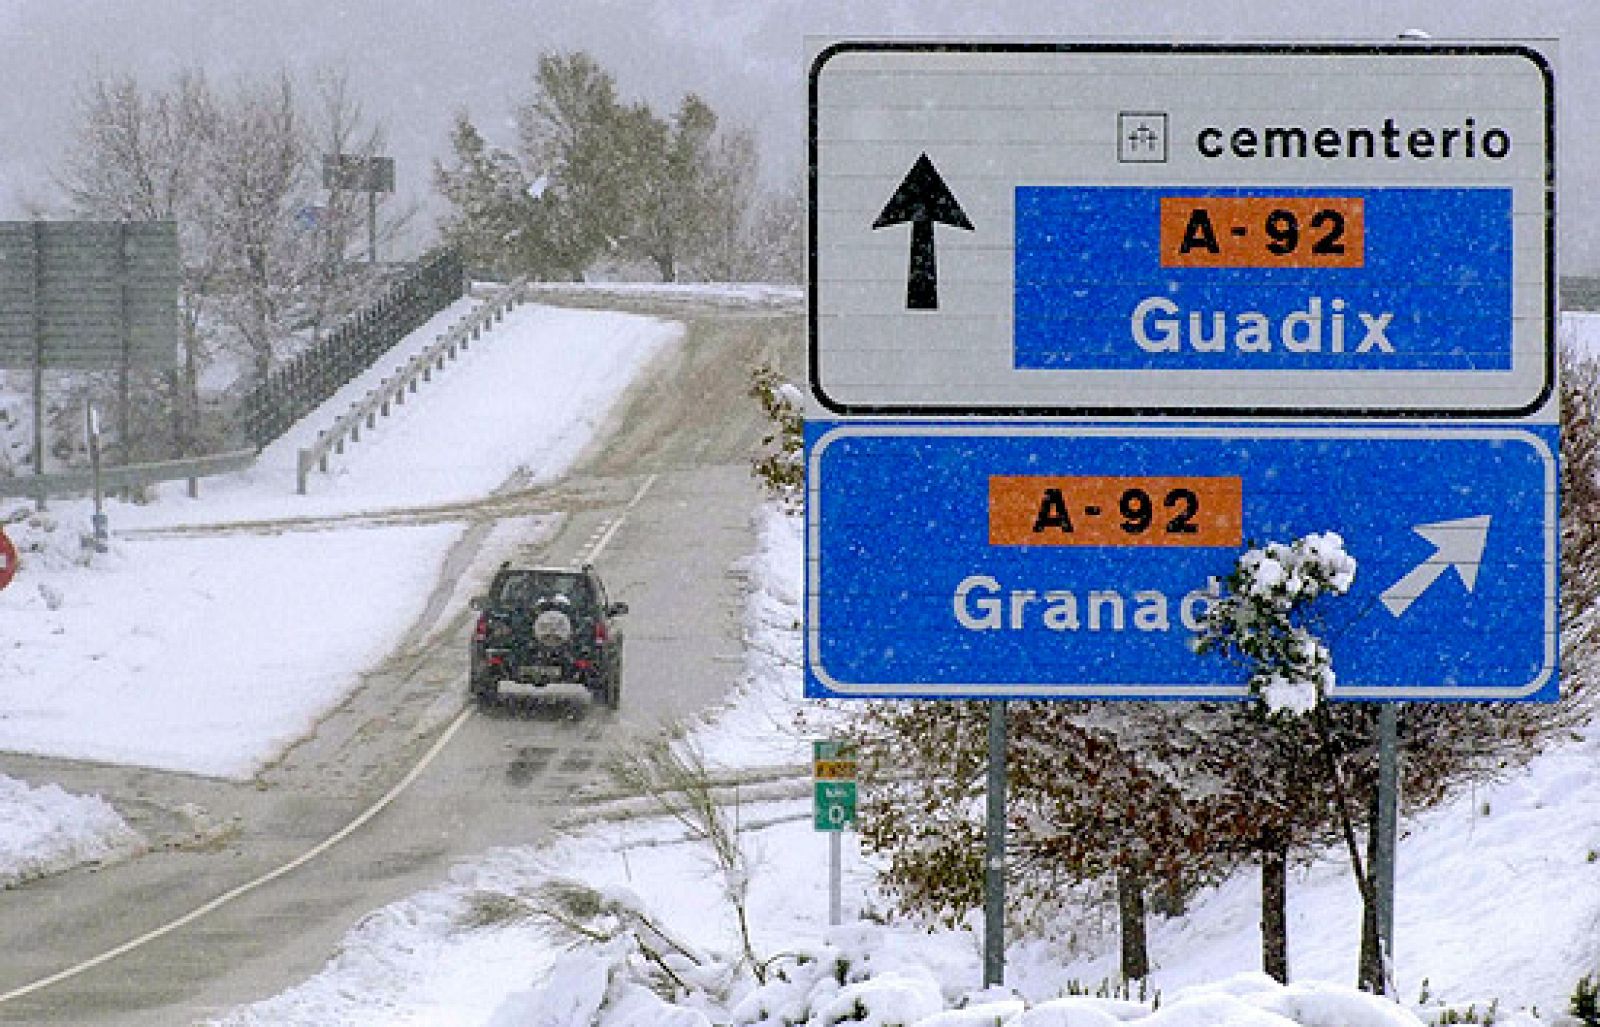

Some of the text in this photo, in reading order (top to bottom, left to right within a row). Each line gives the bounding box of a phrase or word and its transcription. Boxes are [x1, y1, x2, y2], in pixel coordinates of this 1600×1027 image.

[1197, 118, 1511, 158] cementerio
[1178, 208, 1346, 257] A-92
[1131, 297, 1396, 354] Guadix
[1032, 488, 1200, 536] A-92
[953, 575, 1226, 632] Granad
